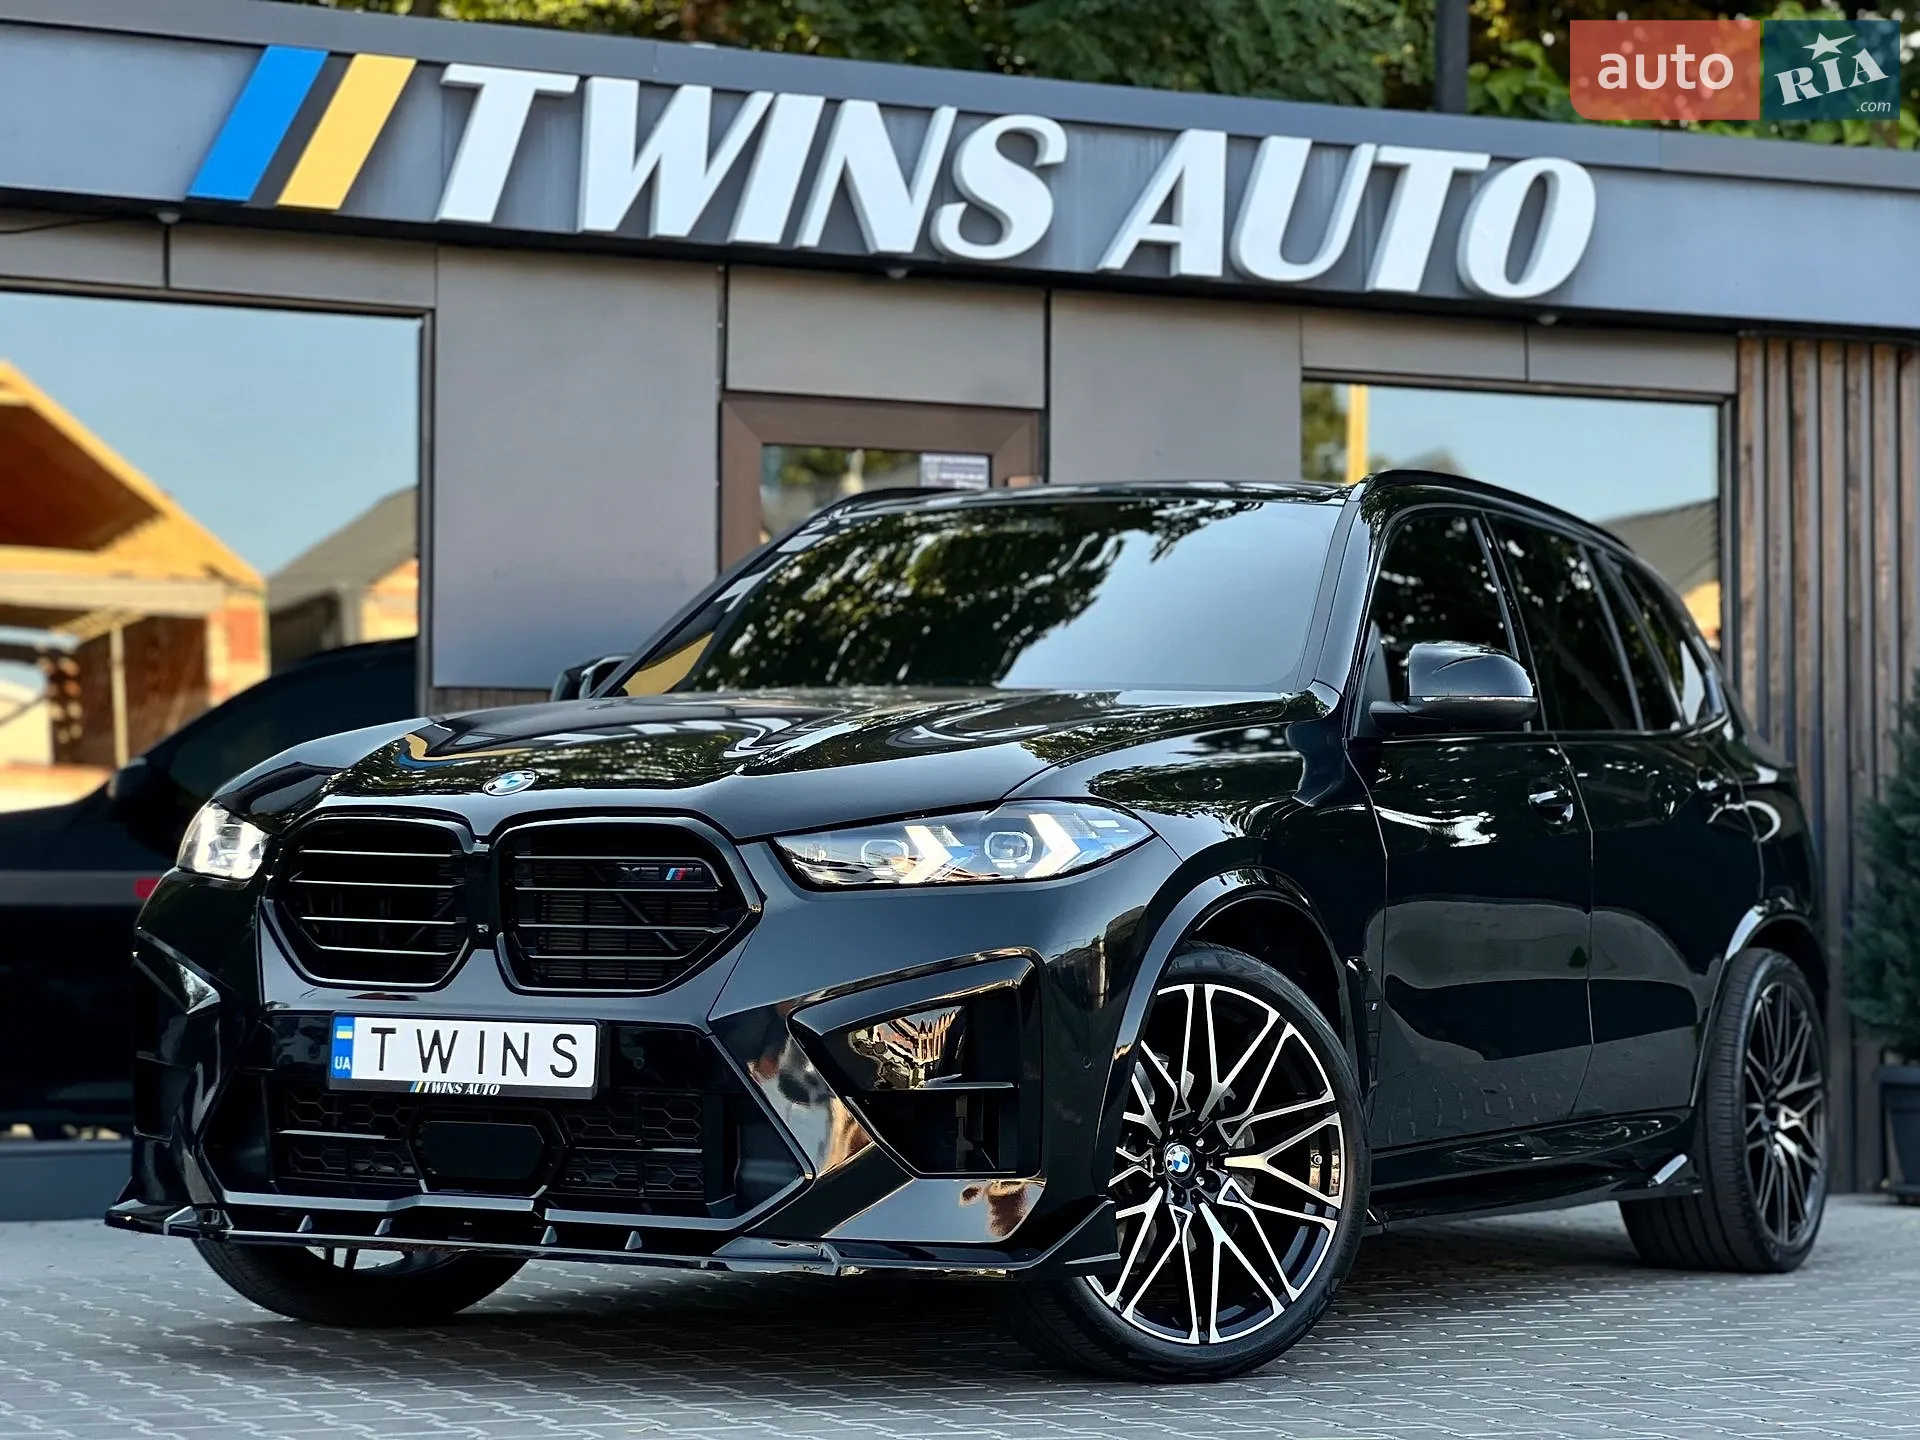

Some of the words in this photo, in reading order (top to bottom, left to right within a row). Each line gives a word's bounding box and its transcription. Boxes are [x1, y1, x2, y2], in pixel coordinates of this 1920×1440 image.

[437, 63, 1068, 261] TWINS
[1095, 128, 1597, 299] AUTO
[334, 1056, 351, 1070] UA
[371, 1027, 578, 1079] TWINS
[423, 1081, 463, 1094] TWINS
[465, 1083, 501, 1096] AUTO
